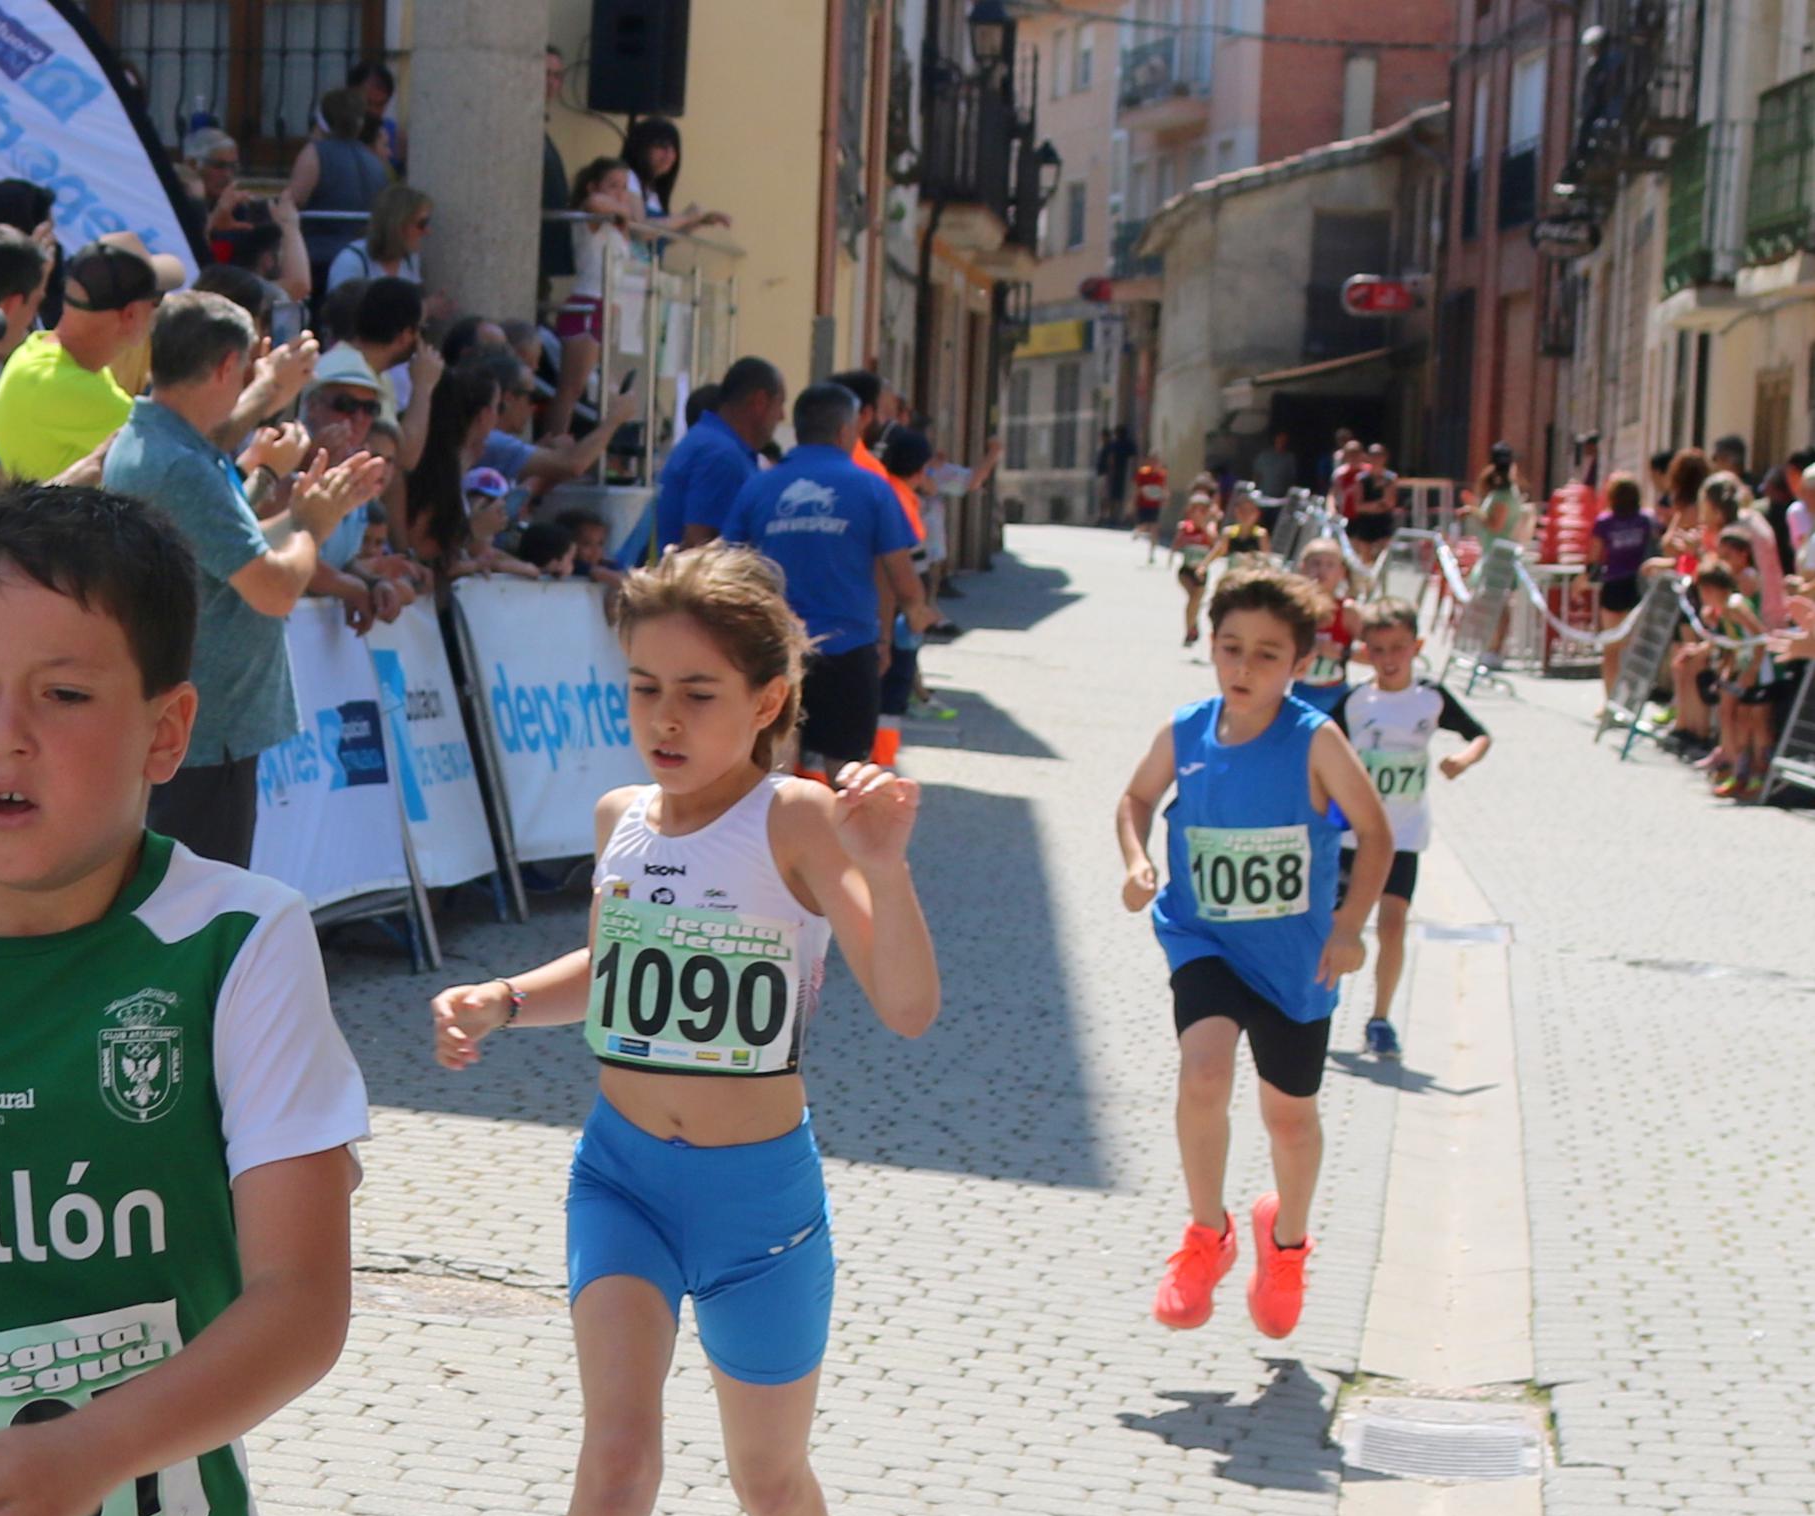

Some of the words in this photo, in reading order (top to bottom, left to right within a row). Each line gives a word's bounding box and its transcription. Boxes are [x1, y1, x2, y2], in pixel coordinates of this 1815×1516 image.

[492, 663, 630, 772] deporte
[1192, 853, 1303, 905] 1068
[666, 915, 780, 944] legua
[672, 931, 790, 960] legua
[595, 941, 786, 1047] 1090
